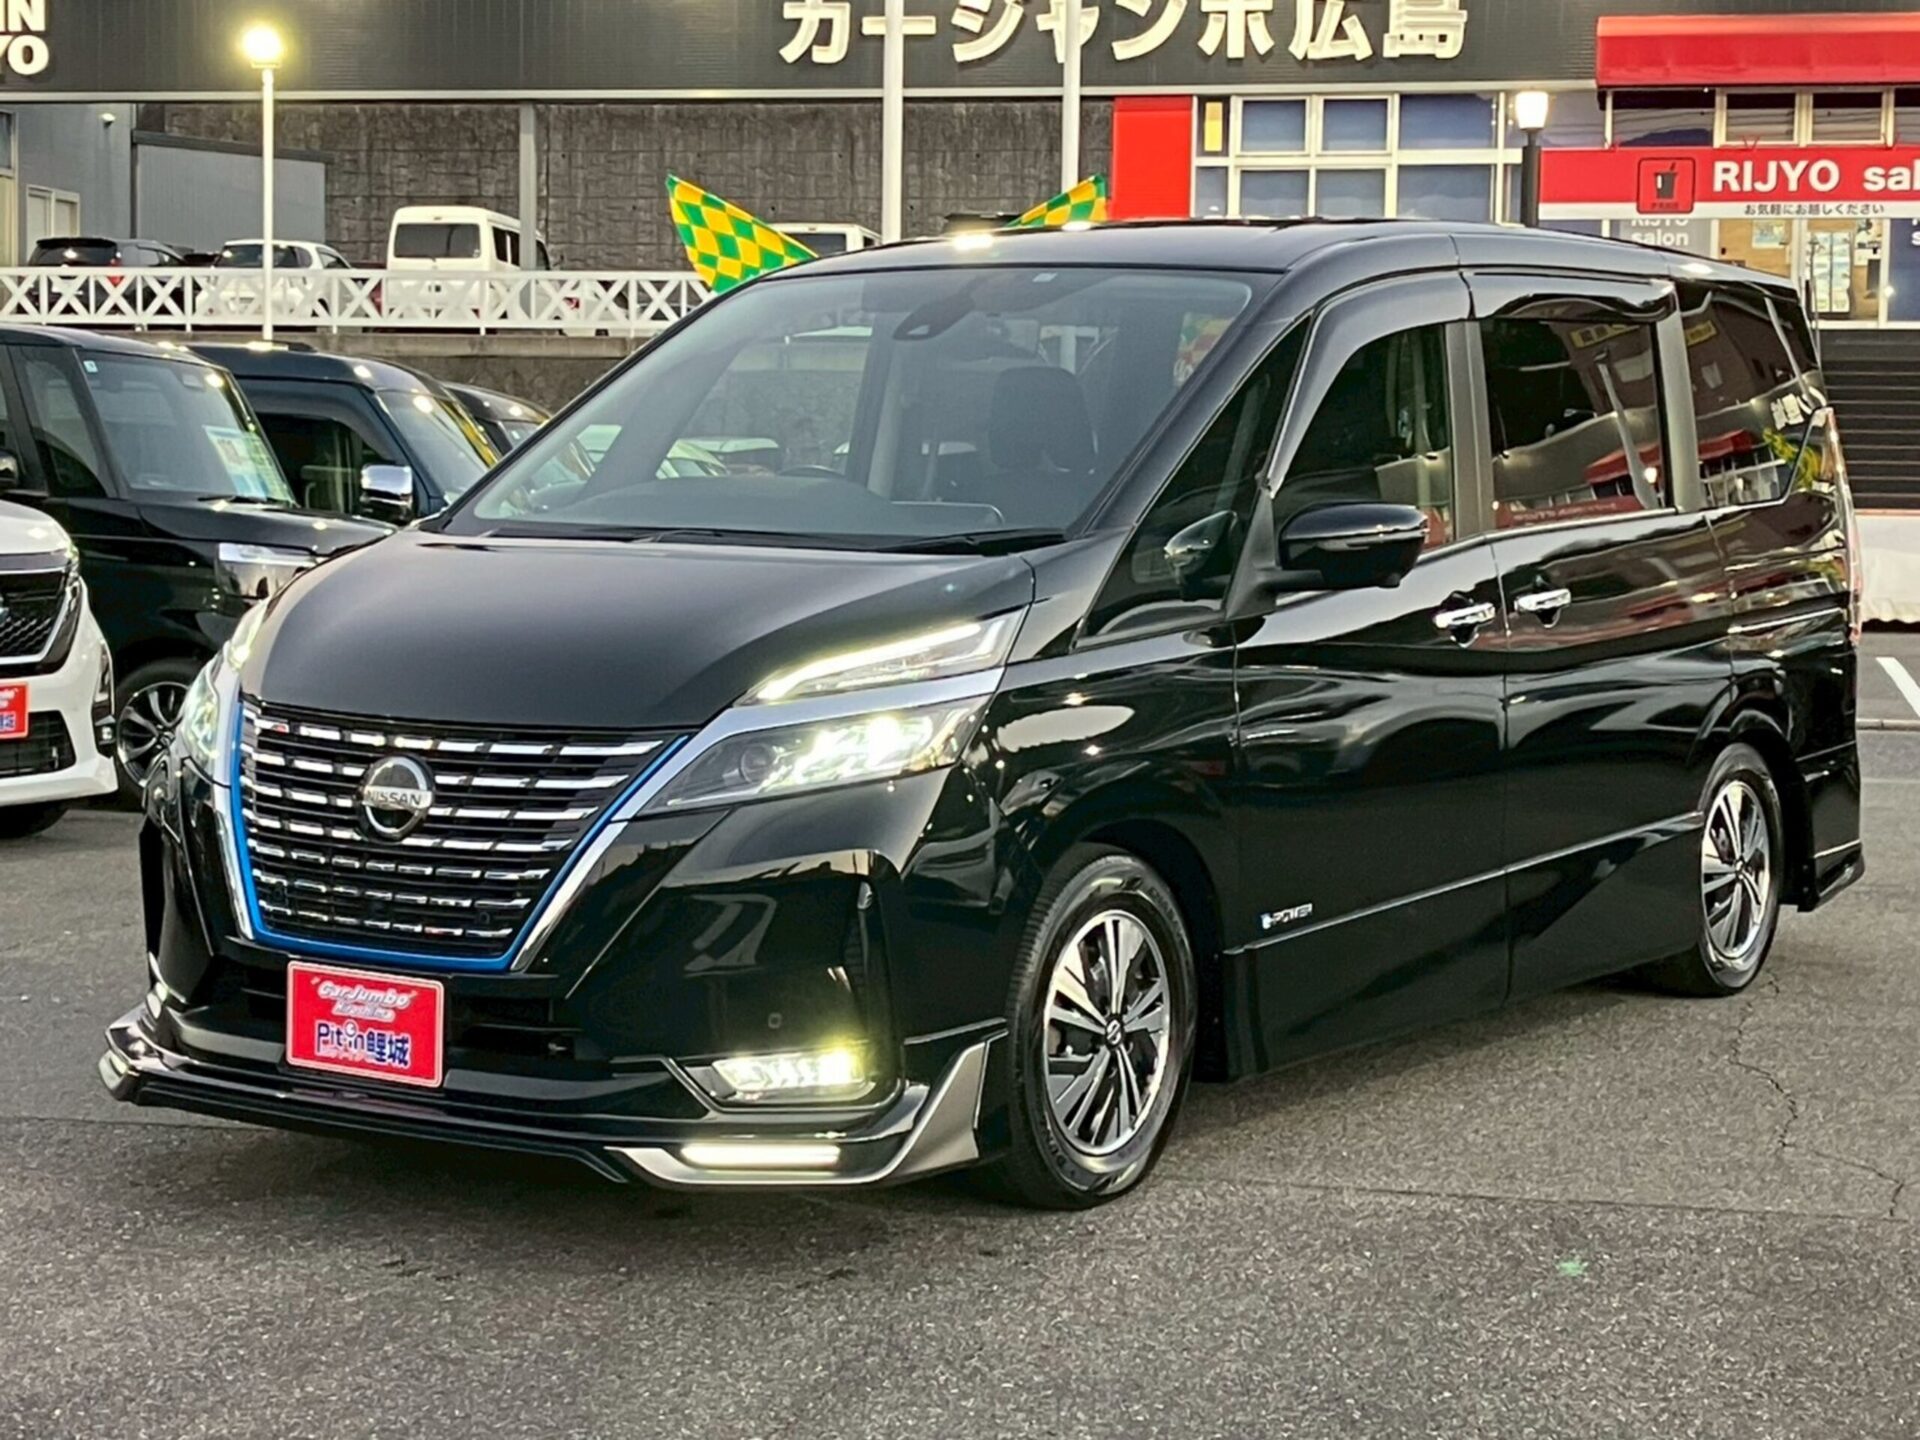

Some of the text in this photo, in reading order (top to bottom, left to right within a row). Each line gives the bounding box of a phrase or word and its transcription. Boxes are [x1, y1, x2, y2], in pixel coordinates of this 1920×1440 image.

[1713, 160, 1840, 192] RIJYO
[1744, 203, 1885, 216] お気軽にお越しください
[1631, 229, 1689, 247] salon
[366, 788, 422, 807] NISSAN
